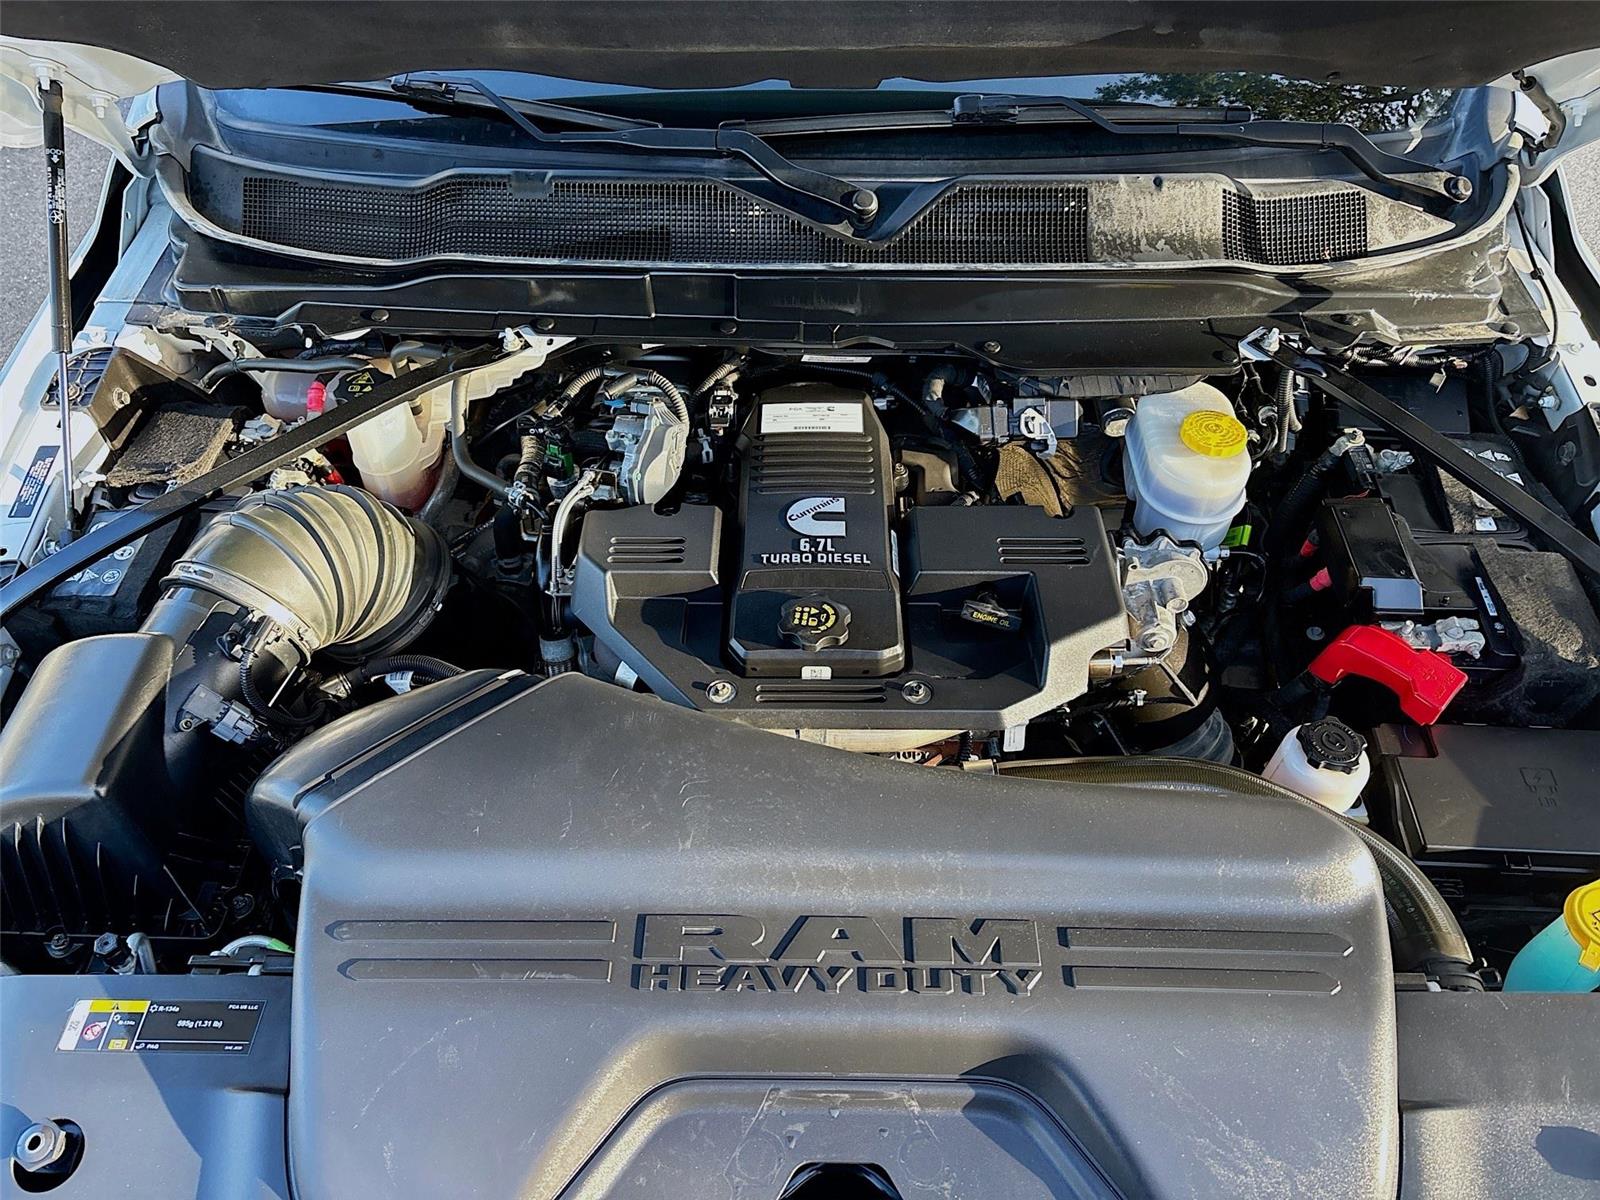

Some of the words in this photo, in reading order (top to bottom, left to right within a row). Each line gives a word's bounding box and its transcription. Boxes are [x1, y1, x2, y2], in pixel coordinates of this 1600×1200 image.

[788, 497, 840, 522] Cummins
[799, 538, 836, 552] 6.7L
[760, 553, 813, 565] TURBO
[817, 553, 871, 565] DIESEL
[972, 611, 998, 624] ENGINE
[999, 619, 1010, 627] OIL
[633, 912, 1042, 966] RAM
